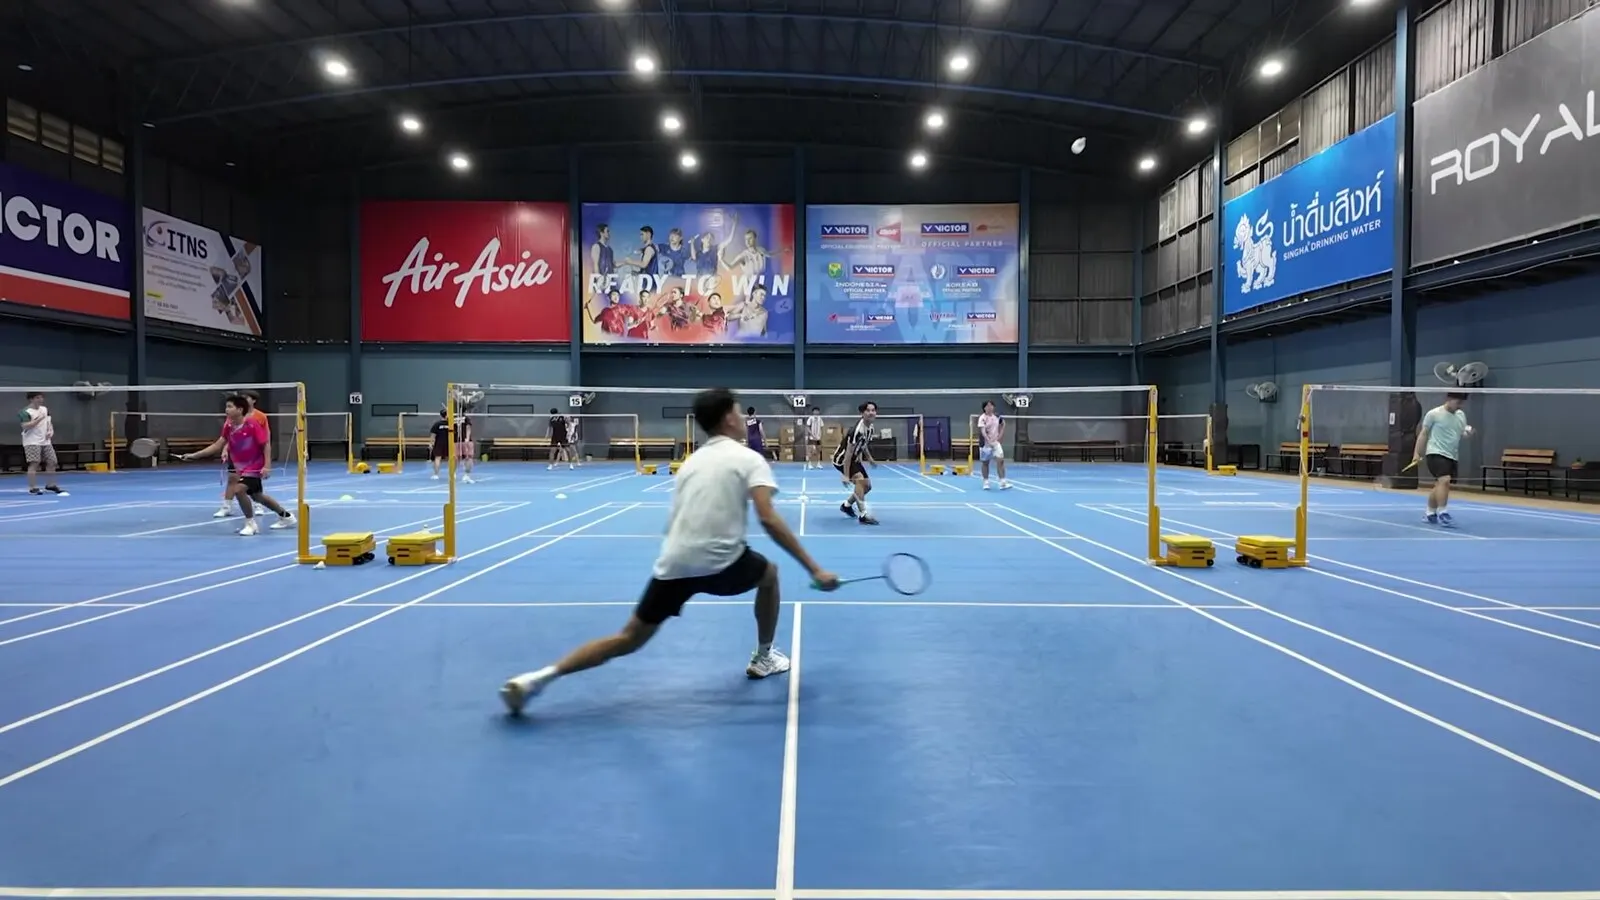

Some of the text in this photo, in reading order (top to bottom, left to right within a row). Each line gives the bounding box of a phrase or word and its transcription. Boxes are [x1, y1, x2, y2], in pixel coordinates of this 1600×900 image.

[1282, 169, 1385, 247] น้ำดื่มสิงห์
[834, 226, 867, 234] VICTOR
[934, 224, 967, 232] VICTOR
[1310, 230, 1349, 251] DRINKING
[1351, 218, 1381, 238] WATER
[167, 228, 208, 259] ITNS
[864, 266, 893, 274] VICTOR
[588, 273, 669, 295] READY
[681, 274, 717, 296] TO
[351, 395, 361, 403] 16
[571, 398, 580, 406] 15
[795, 398, 804, 406] 14
[1018, 398, 1027, 406] 13
